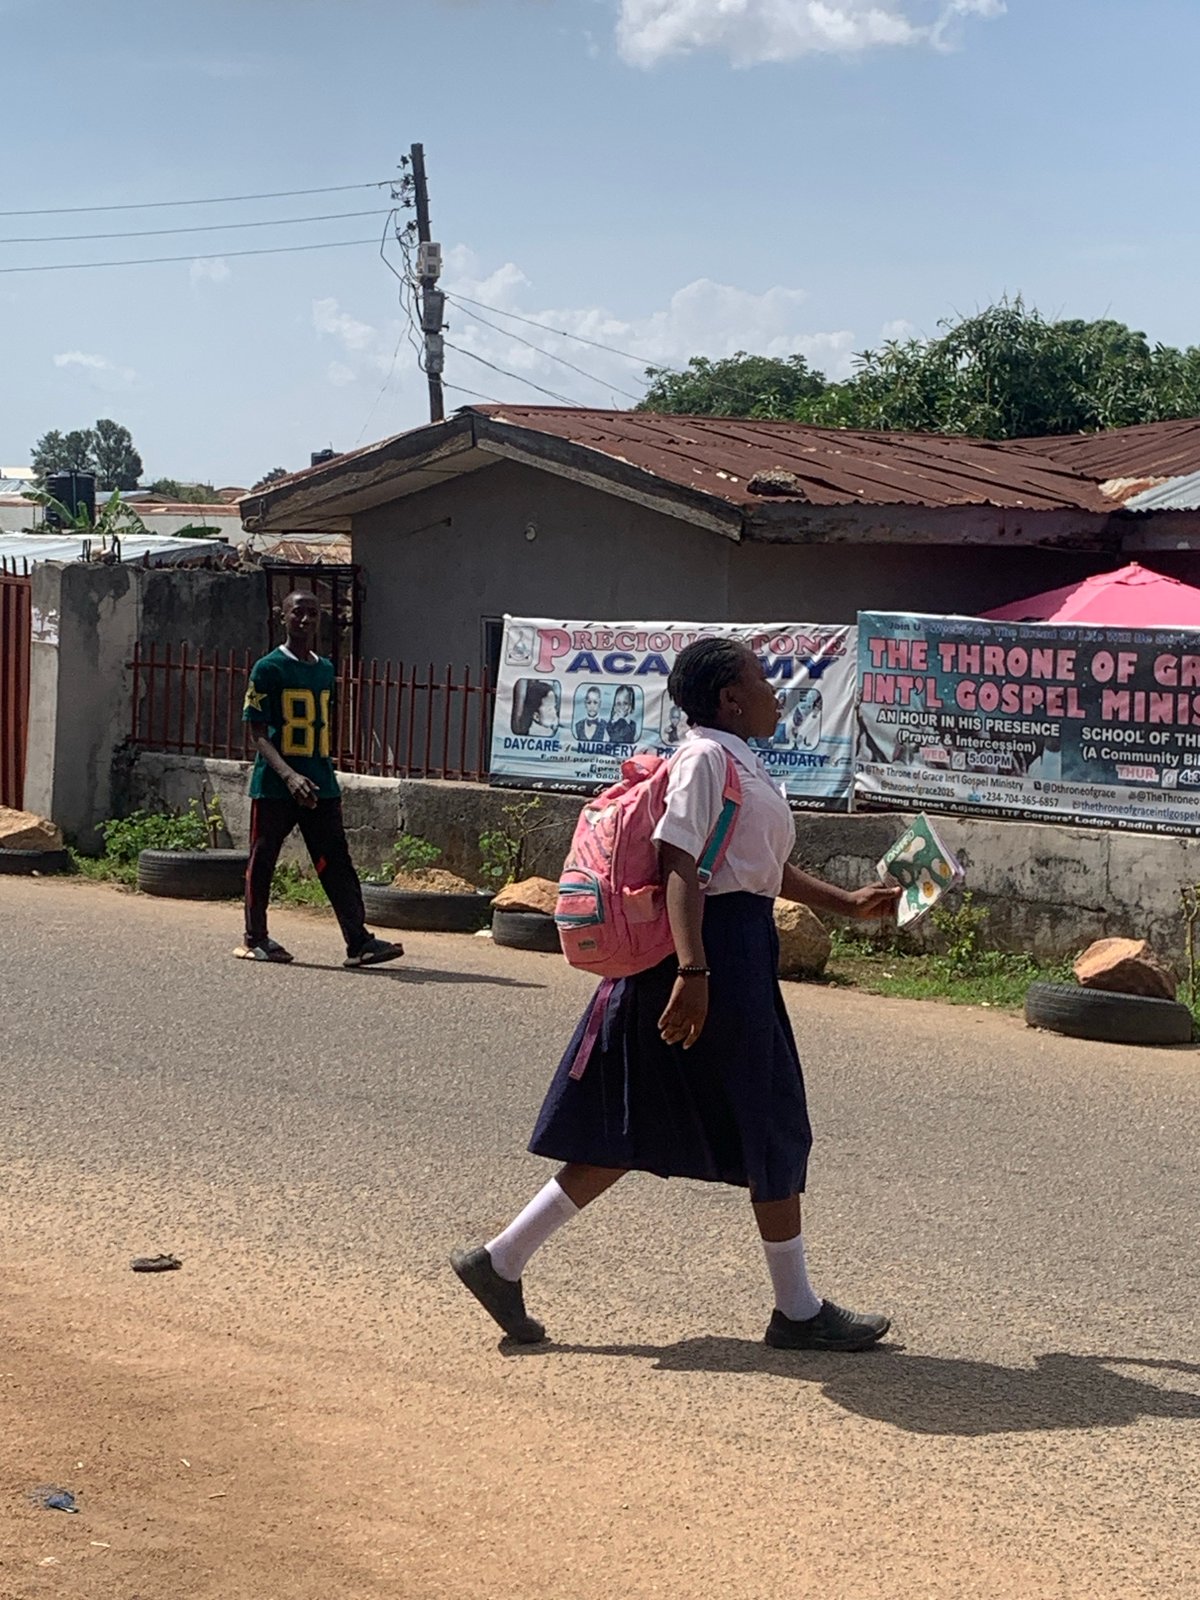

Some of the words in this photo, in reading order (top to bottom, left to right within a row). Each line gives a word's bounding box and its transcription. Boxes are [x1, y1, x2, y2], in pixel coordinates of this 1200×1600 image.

[534, 628, 716, 673] PRECIOU
[868, 637, 929, 672] THE
[938, 641, 1077, 683] THRONE
[1090, 649, 1138, 684] OF
[1153, 652, 1200, 688] GR
[565, 651, 839, 680] ACAMY
[862, 672, 944, 709] INT'L
[955, 678, 1087, 719] GOSPEL
[877, 709, 897, 723] AN
[899, 711, 938, 727] HOUR
[940, 715, 956, 728] IN
[958, 717, 983, 731] HIS
[985, 719, 1060, 737] PRESENCE
[1082, 726, 1145, 744] SCHOOL
[1149, 731, 1170, 745] OF
[504, 737, 560, 752] DAYCARE
[897, 729, 941, 748] (Prayer
[943, 734, 952, 745] &
[956, 734, 1036, 755] Intercession)
[968, 752, 1011, 767] 5:00PM
[1082, 746, 1097, 760] (A
[1100, 748, 1179, 768] Community
[887, 765, 911, 778] Throne
[913, 769, 920, 779] of
[922, 770, 944, 782] Grace
[962, 775, 988, 789] Gospel
[990, 778, 1024, 791] Ministry
[1180, 770, 1200, 783] 4:3
[1137, 790, 1200, 805] @TheThroneo
[950, 803, 999, 816] Adjacent
[1118, 820, 1153, 831] Dadin
[1157, 823, 1192, 834] Kowa
